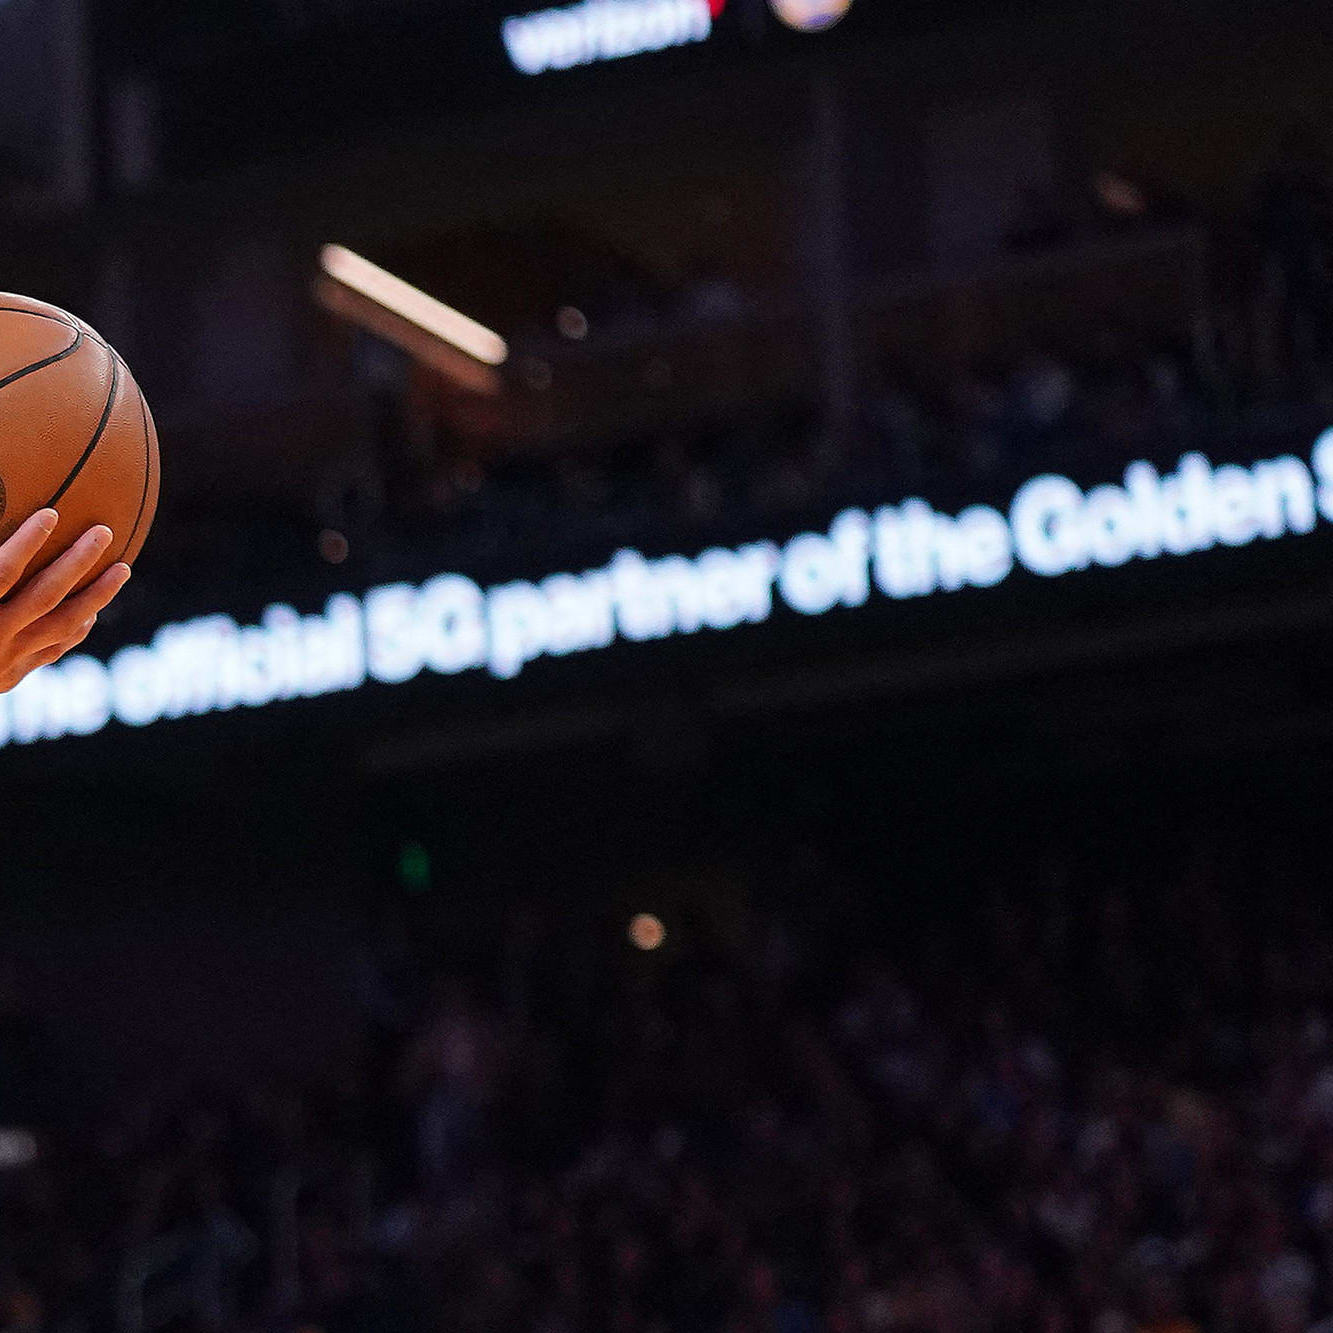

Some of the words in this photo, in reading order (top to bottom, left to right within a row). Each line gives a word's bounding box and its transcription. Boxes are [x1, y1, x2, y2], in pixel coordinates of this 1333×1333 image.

[110, 592, 366, 727] official
[485, 547, 780, 679] partner
[778, 506, 870, 614] of
[872, 496, 1013, 599] the
[1009, 450, 1317, 576] Golden
